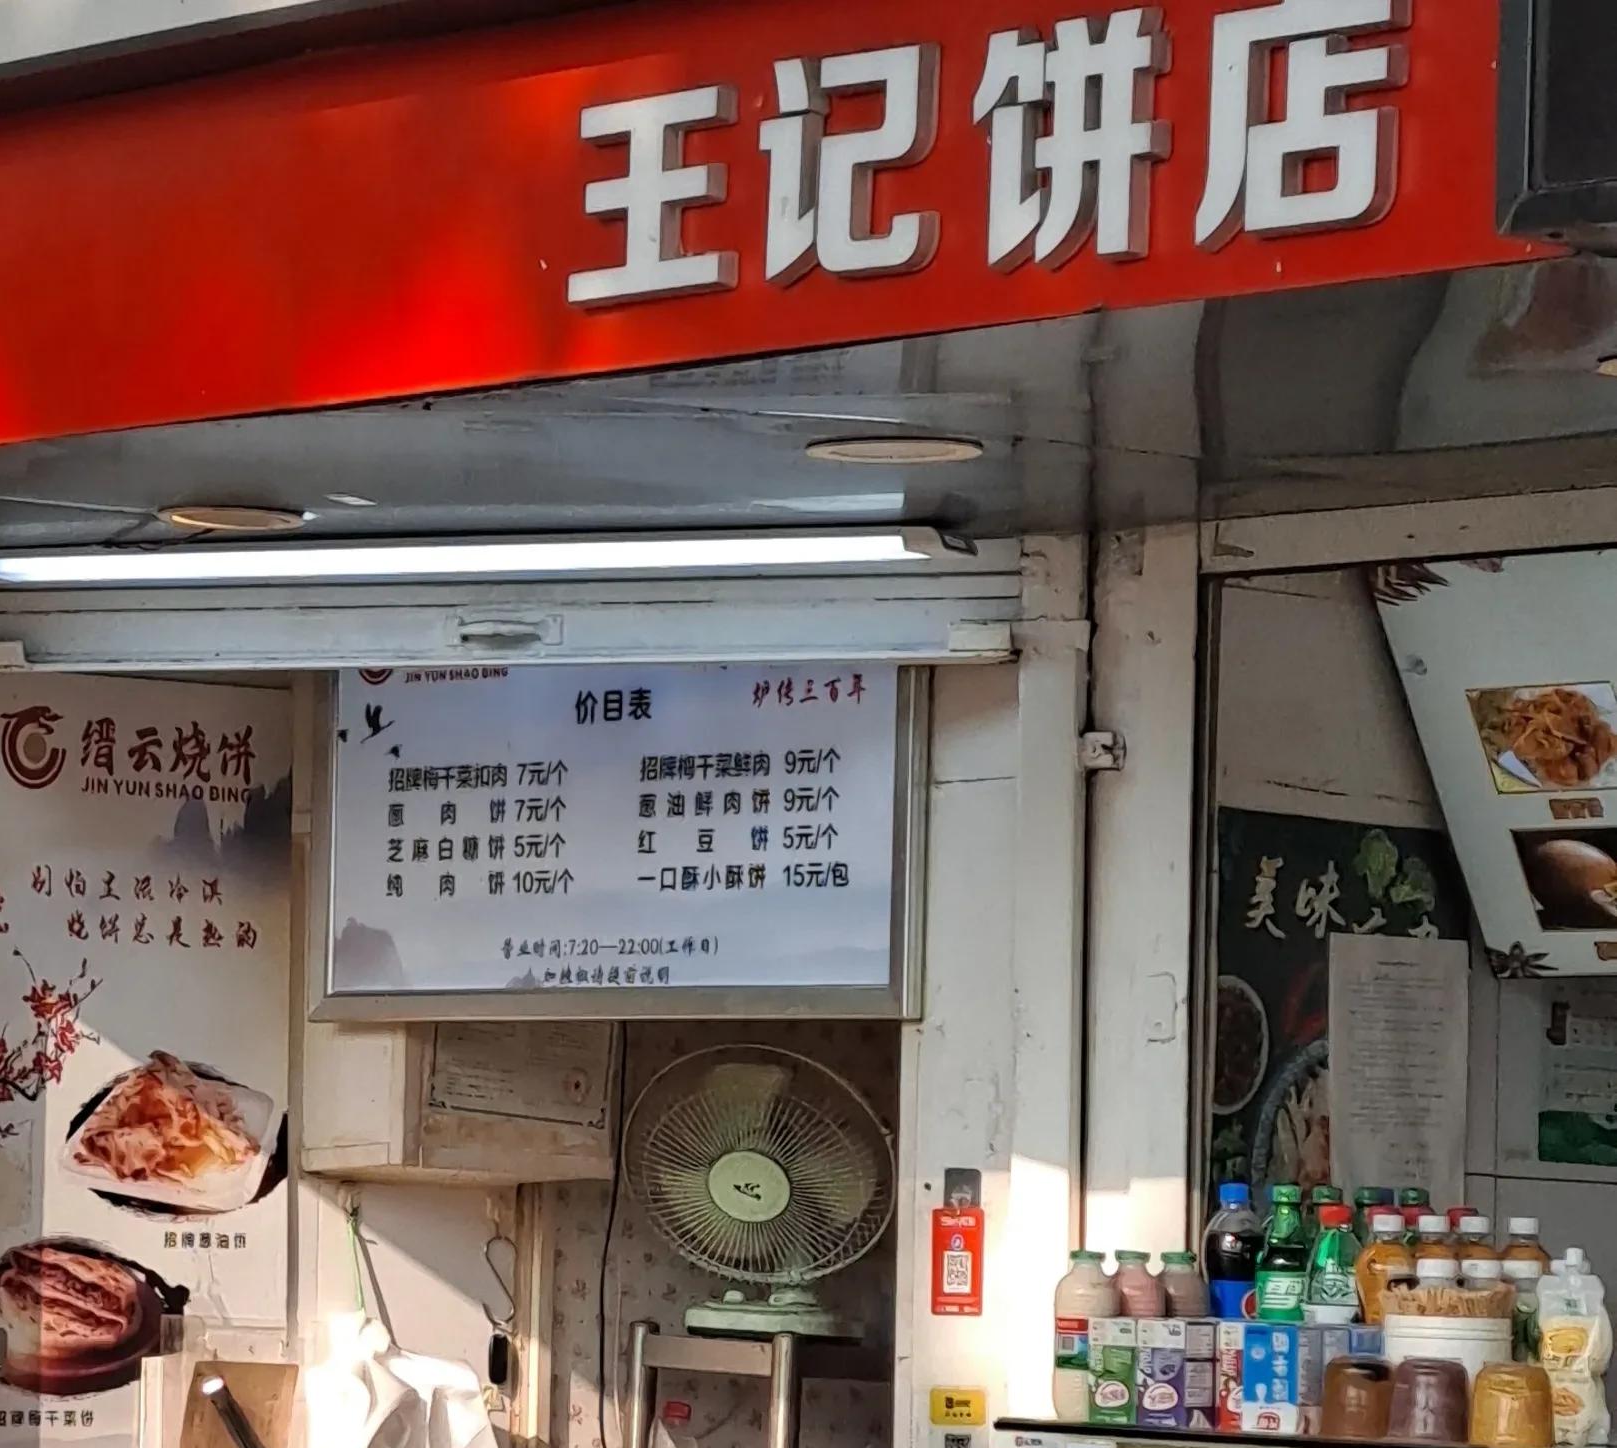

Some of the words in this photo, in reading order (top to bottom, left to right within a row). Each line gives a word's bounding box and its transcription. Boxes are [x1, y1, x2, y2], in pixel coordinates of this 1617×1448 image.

[567, 0, 1411, 308] 王记饼店
[575, 687, 652, 725] 价目表
[81, 717, 256, 785] 缙云烧饼
[388, 763, 508, 792] 招牌梅干菜扣肉
[517, 760, 569, 787] 7元/个
[640, 751, 770, 782] 招牌梅干菜鲜肉
[784, 748, 841, 775] 9元/个
[81, 776, 108, 794] JIN
[114, 779, 150, 797] YUN
[155, 782, 204, 800] SHAO
[209, 785, 251, 803] BING
[782, 786, 840, 812] 9元/个
[514, 796, 566, 822] 7元/个
[513, 833, 566, 858] 5元/个
[782, 824, 839, 850] 5元/个
[512, 868, 574, 894] 10元/个
[783, 862, 850, 888] 15元/包
